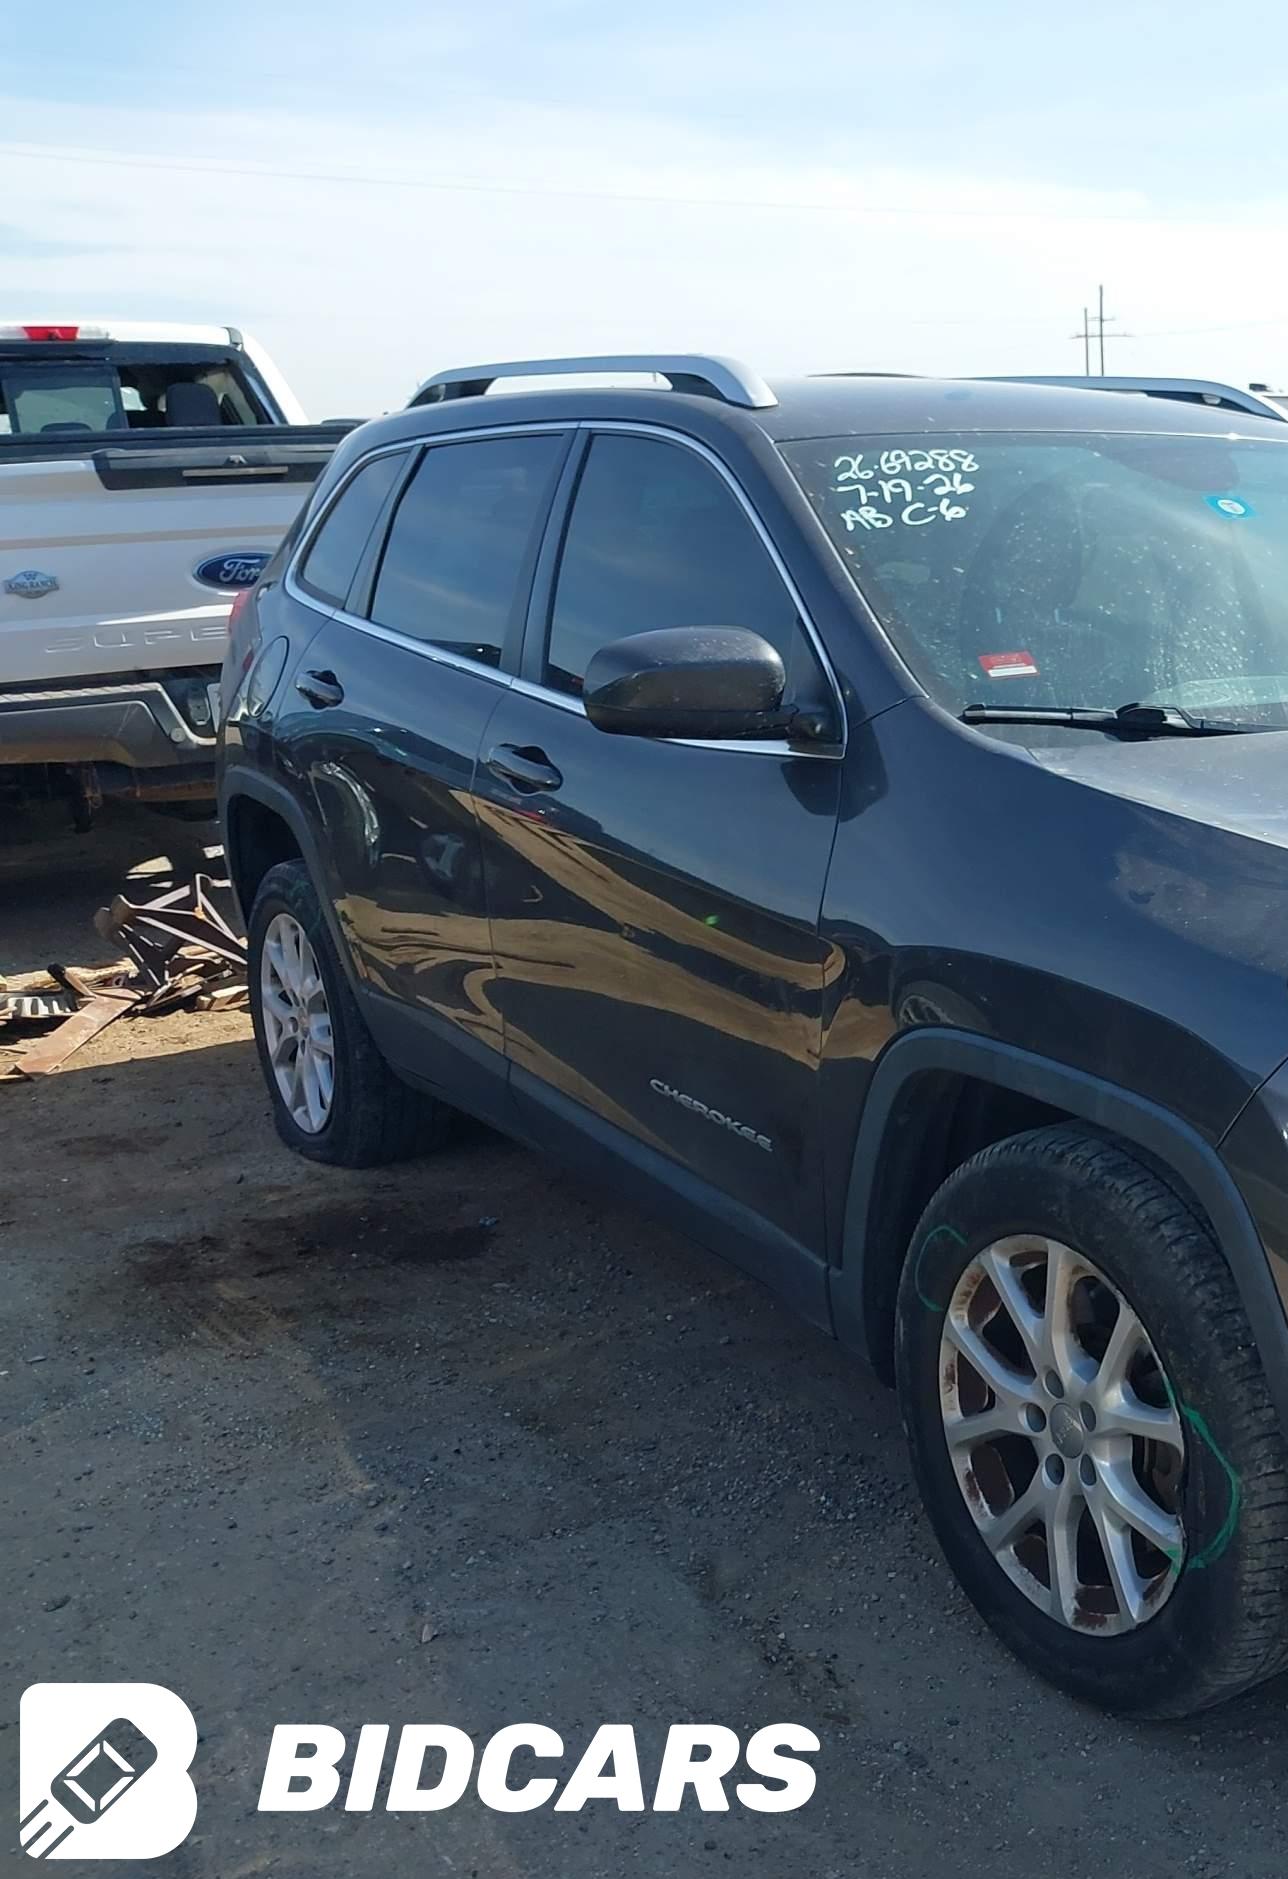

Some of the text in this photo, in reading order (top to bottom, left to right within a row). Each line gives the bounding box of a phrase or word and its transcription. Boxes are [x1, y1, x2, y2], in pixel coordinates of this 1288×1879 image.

[219, 558, 262, 582] For
[45, 625, 228, 653] SUPE
[649, 1078, 773, 1152] CHEROKEE
